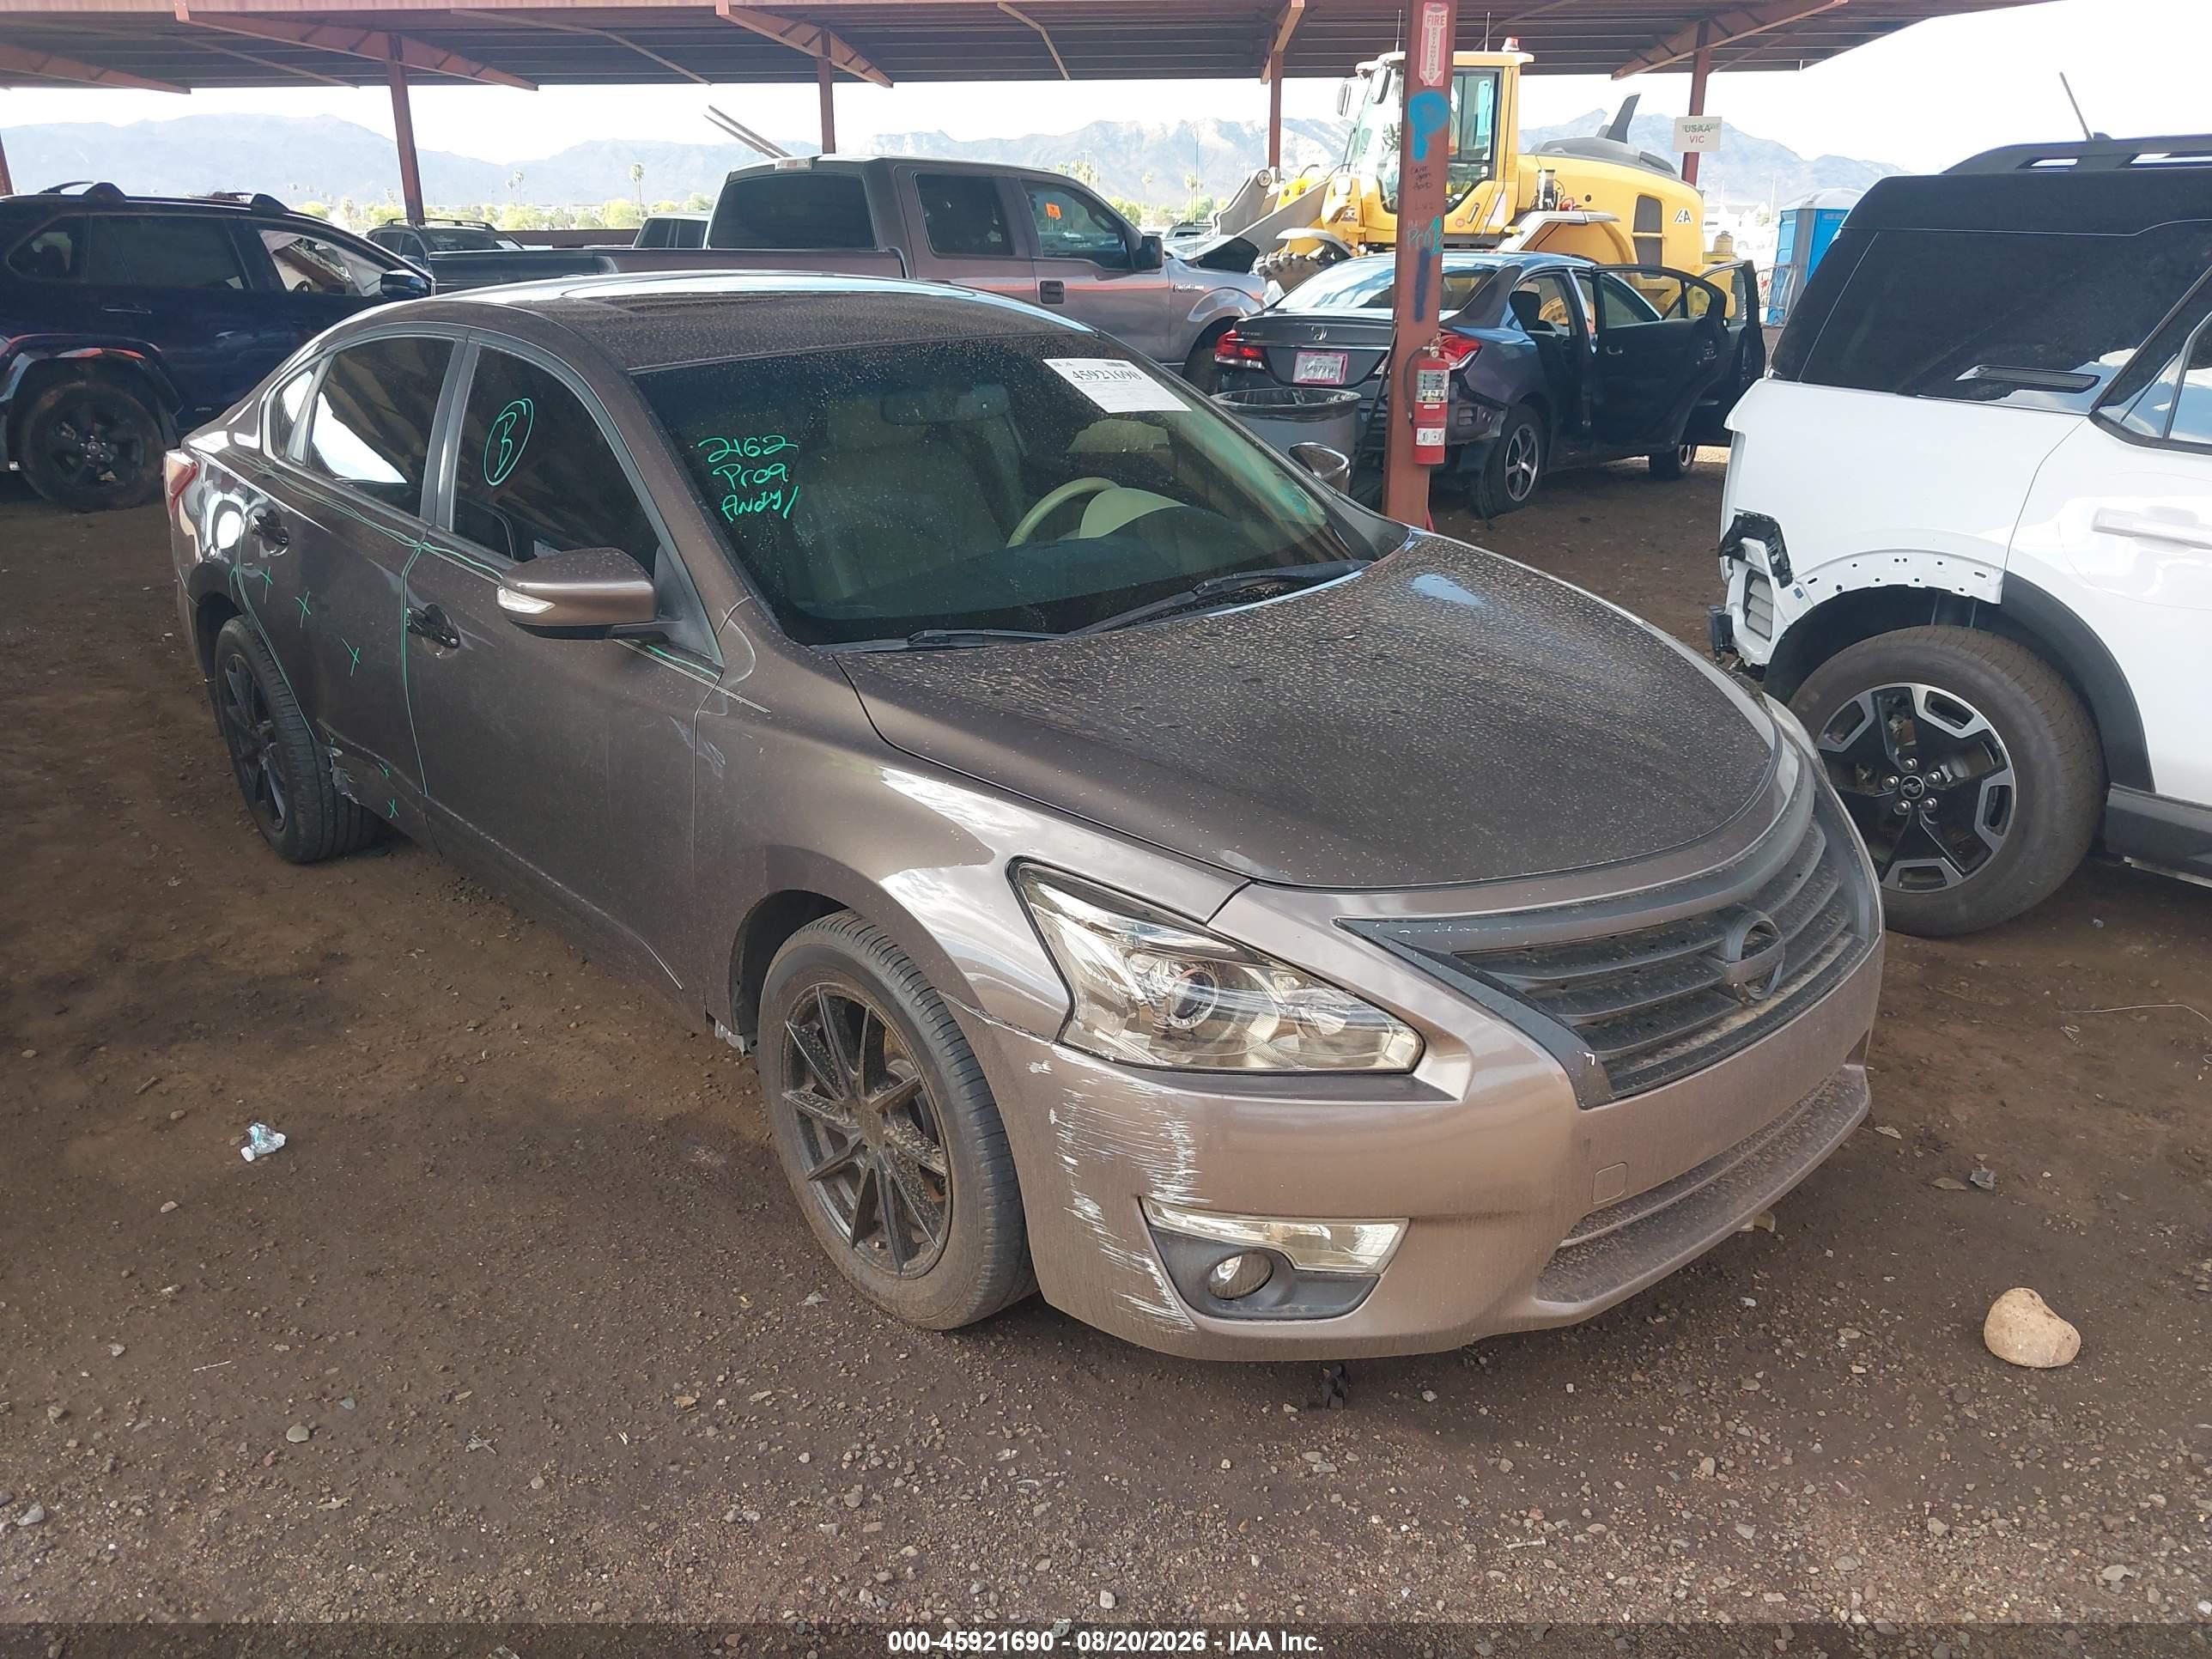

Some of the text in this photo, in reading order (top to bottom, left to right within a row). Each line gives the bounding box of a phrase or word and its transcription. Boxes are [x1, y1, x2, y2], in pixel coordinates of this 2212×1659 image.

[1426, 15, 1445, 26] FIRE
[1409, 94, 1448, 161] P
[1684, 125, 1711, 133] USAA
[1689, 135, 1705, 144] VIC
[1073, 369, 1142, 381] 45921690
[697, 434, 799, 463] 2162
